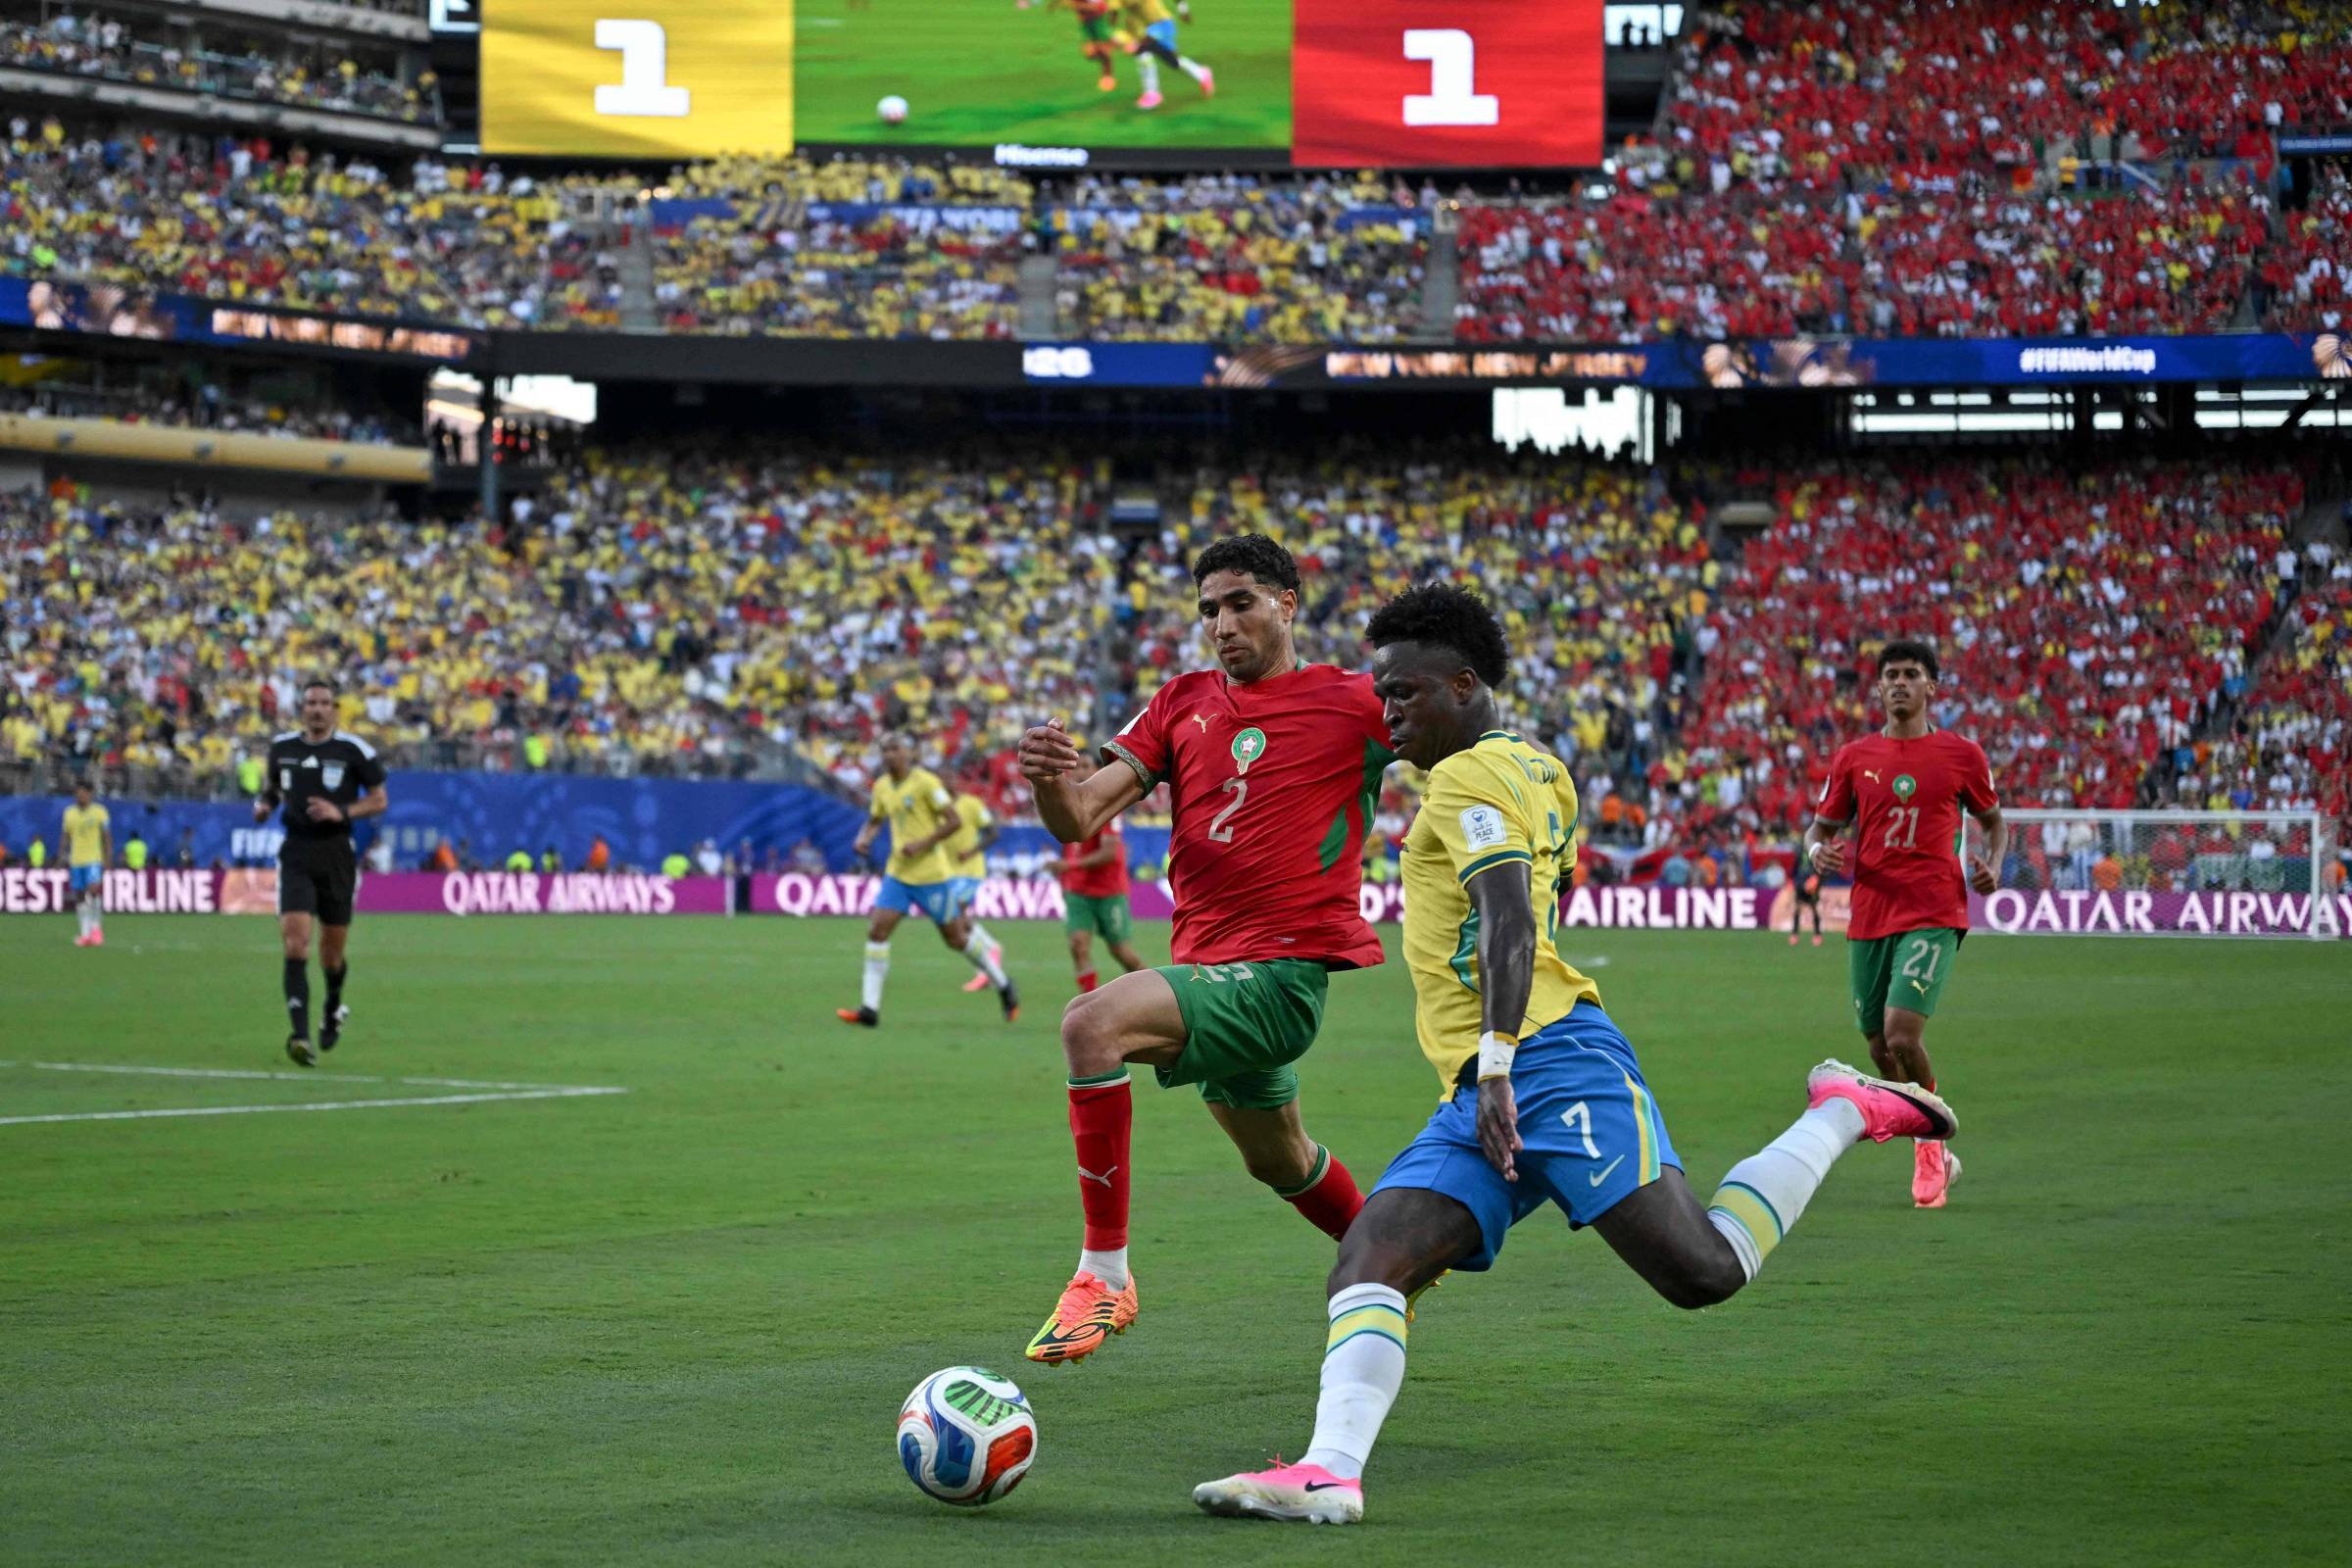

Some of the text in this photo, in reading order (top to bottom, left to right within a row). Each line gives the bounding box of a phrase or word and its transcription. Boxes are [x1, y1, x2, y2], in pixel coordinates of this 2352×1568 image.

[594, 19, 690, 117] 1
[1402, 28, 1499, 125] 1
[1207, 776, 1248, 843] 2
[1884, 806, 1920, 849] 21
[0, 867, 215, 913] EST IRLINE
[443, 871, 675, 915] QATAR AIRWAYS
[1564, 886, 1759, 929] AIRLINE
[1984, 889, 2156, 935] QATAR
[1902, 939, 1942, 982] 21
[1560, 1101, 1601, 1159] 7
